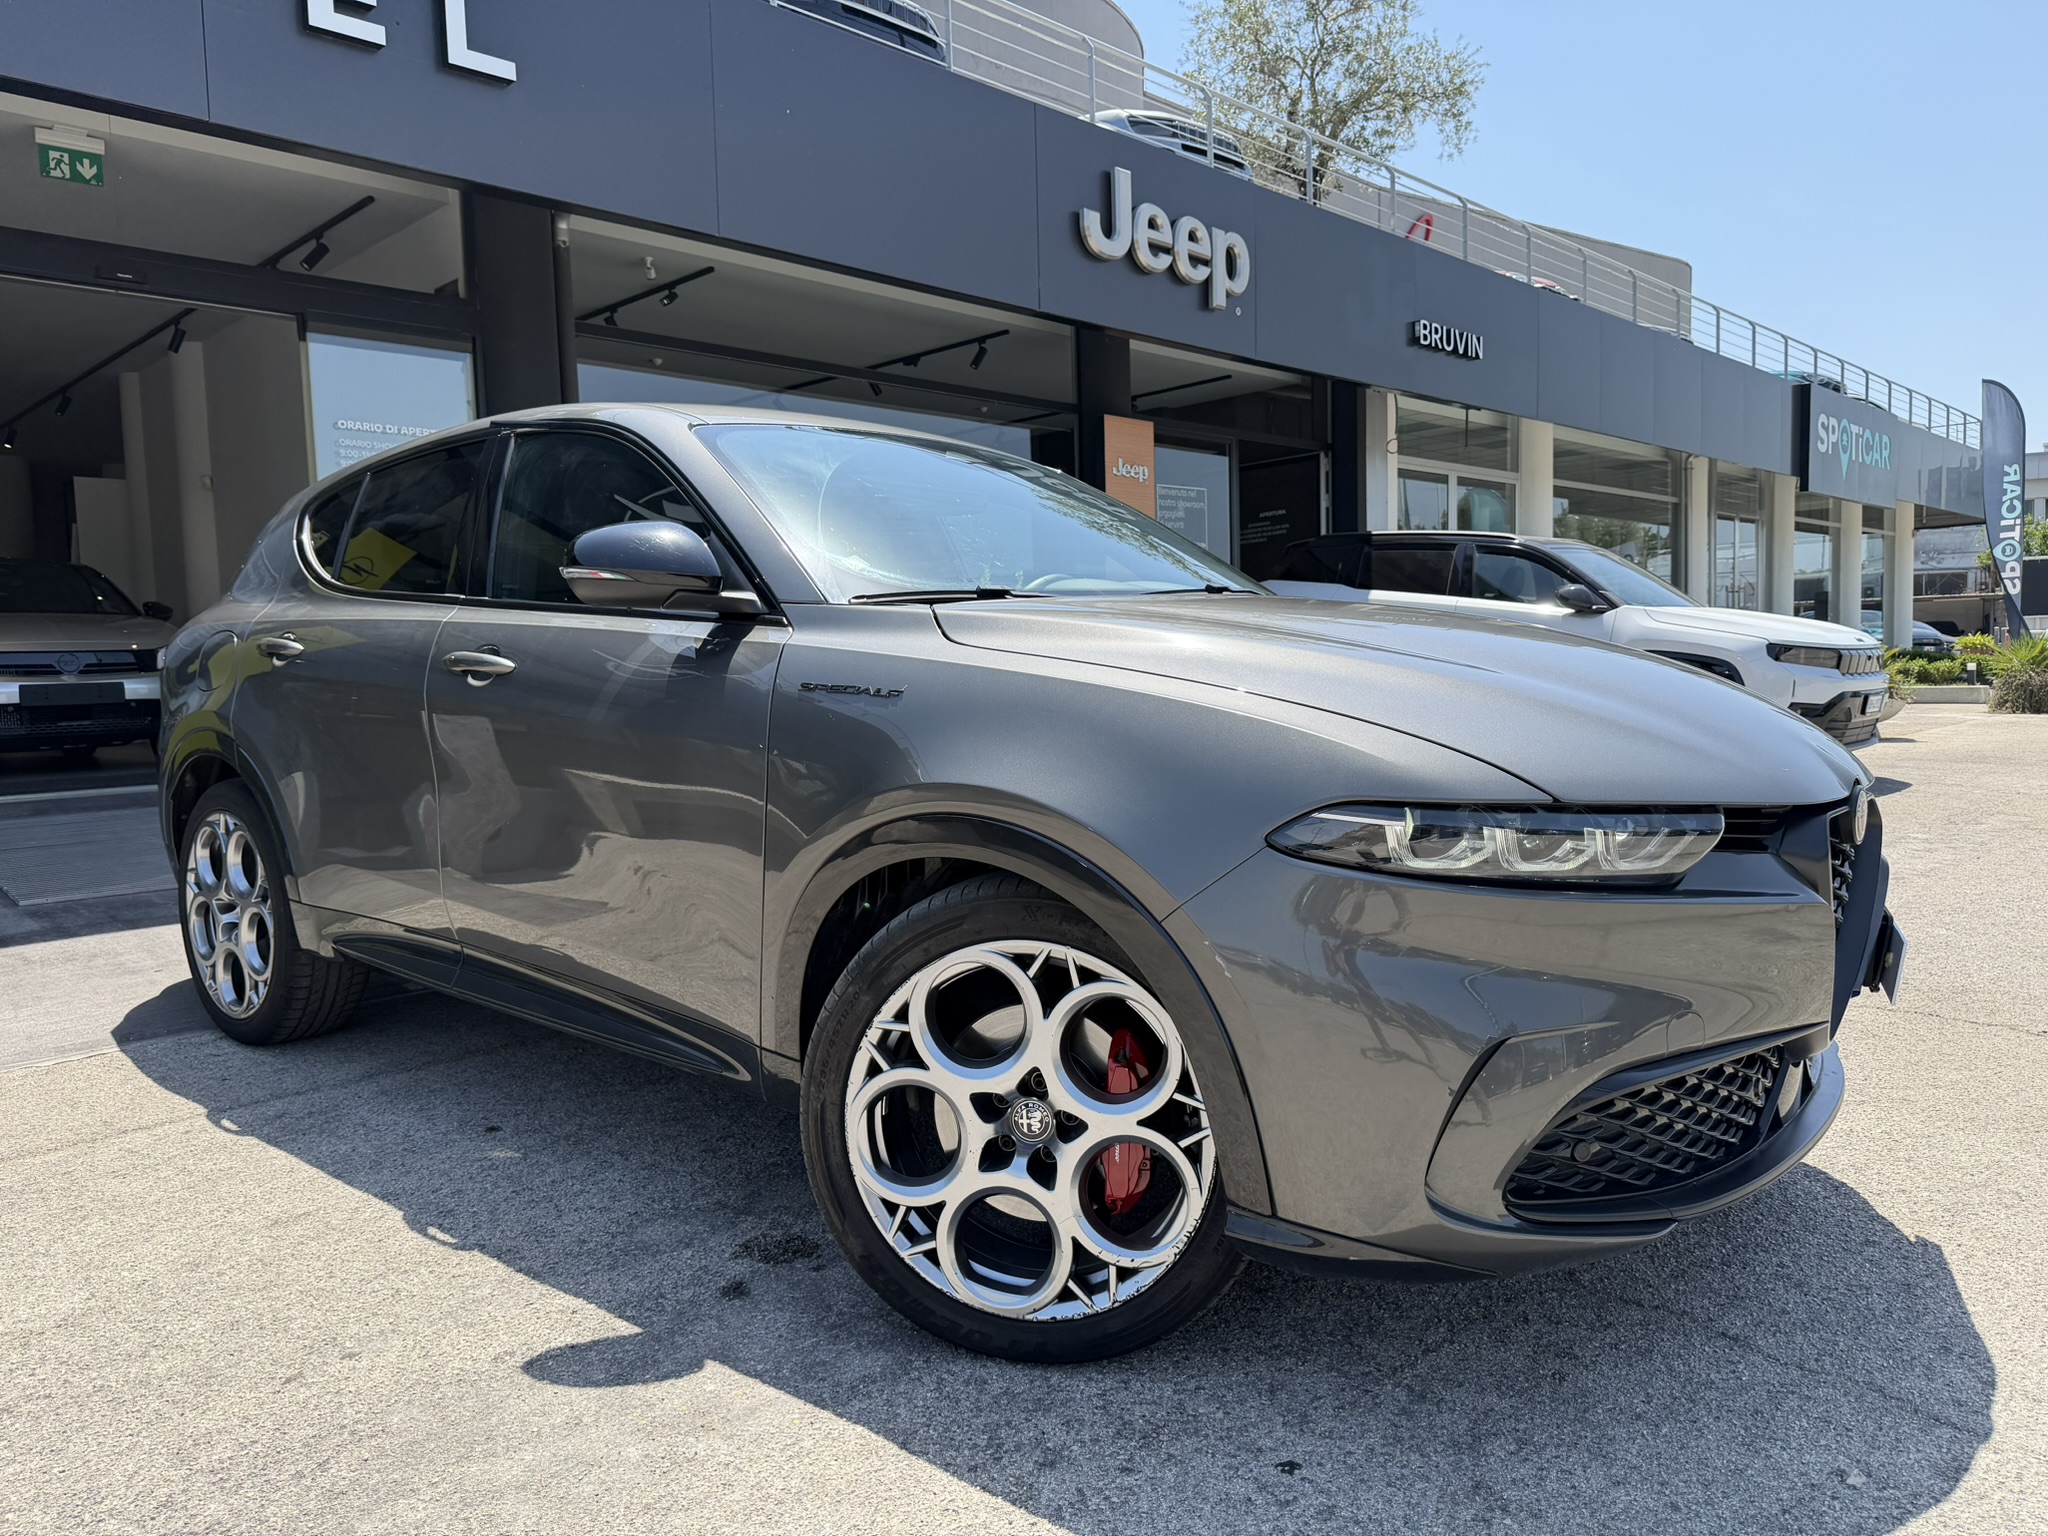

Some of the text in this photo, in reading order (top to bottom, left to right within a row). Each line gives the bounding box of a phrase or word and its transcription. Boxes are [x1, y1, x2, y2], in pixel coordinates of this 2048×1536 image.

[1079, 166, 1251, 310] Jeep
[1419, 319, 1484, 360] BRUVIN
[337, 419, 383, 433] ORARIO
[385, 424, 398, 434] DI
[1112, 457, 1149, 483] Jeep
[1014, 1102, 1050, 1122] ALFA ROMEO
